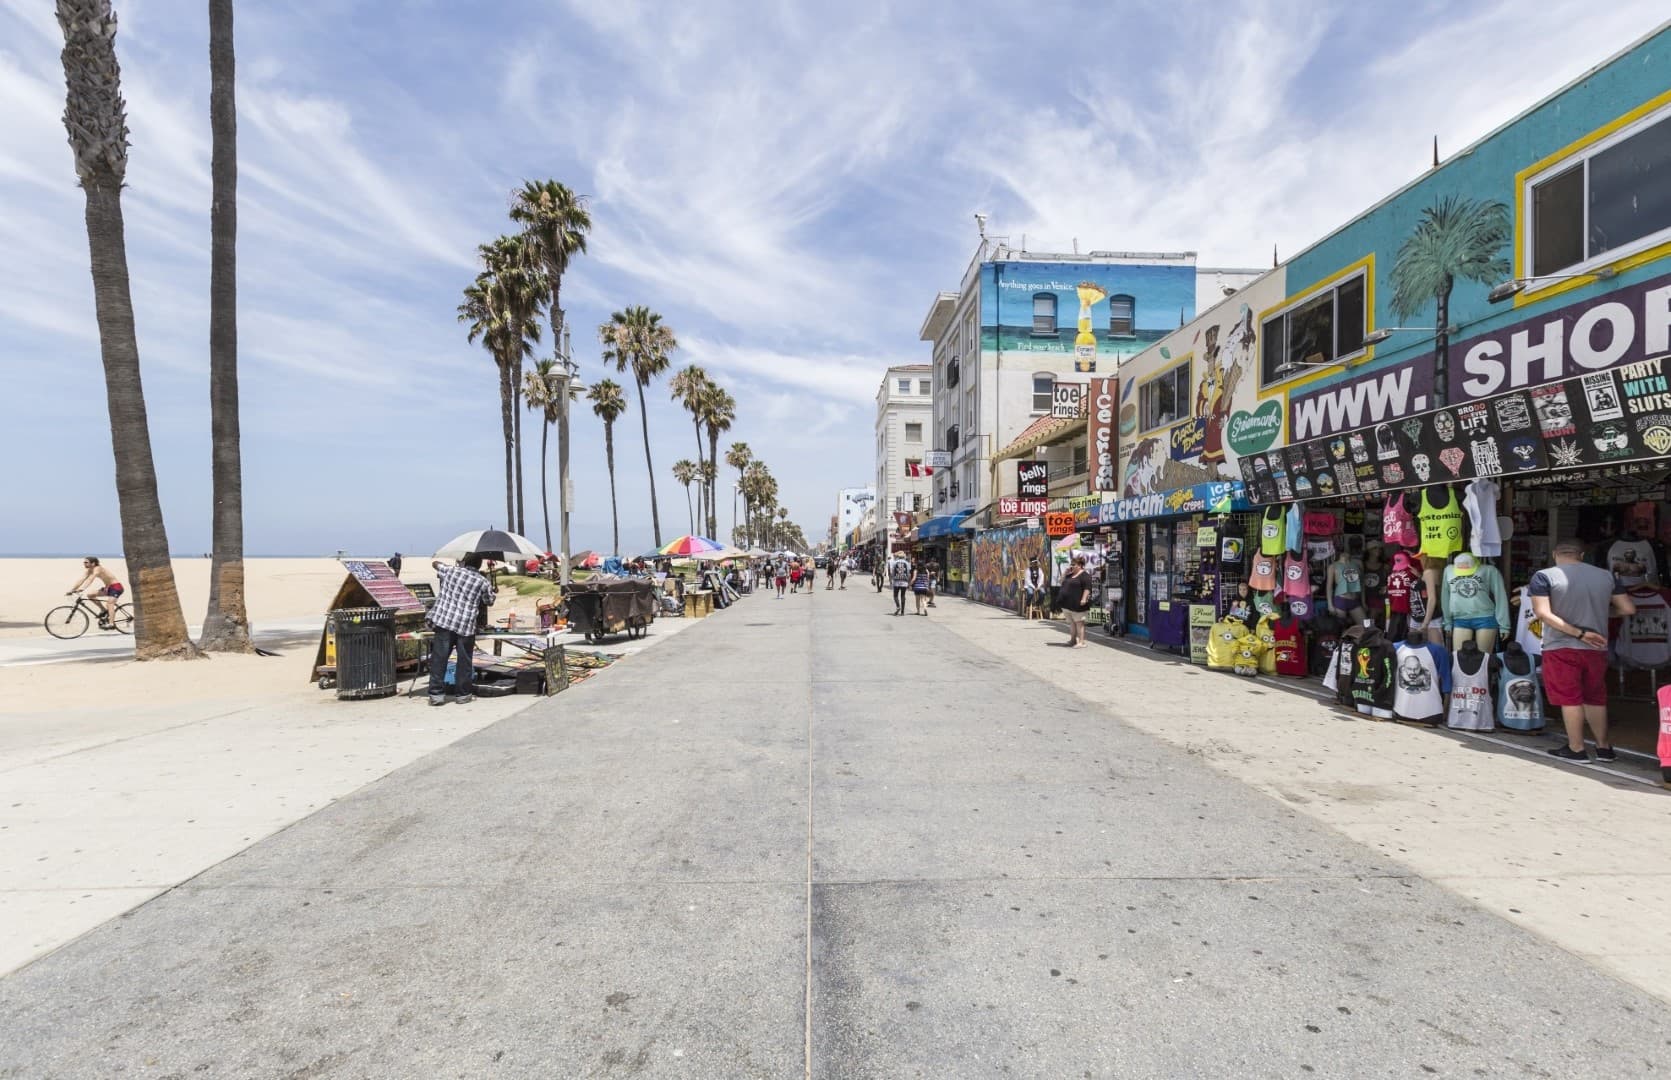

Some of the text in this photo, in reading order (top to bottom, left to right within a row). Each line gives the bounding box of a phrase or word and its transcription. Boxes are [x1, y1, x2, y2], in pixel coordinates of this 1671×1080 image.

[999, 279, 1027, 291] Anything
[1028, 283, 1043, 291] goes
[1051, 281, 1074, 291] Venice.
[1620, 359, 1662, 381] PARTY
[1583, 371, 1612, 386] MISSING
[1623, 375, 1668, 397] WITH
[1053, 386, 1079, 403] toe
[1053, 404, 1079, 416] rings
[1295, 366, 1427, 440] WWW.
[1458, 403, 1486, 415] BRO DO
[1628, 392, 1671, 414] SLUTS
[1460, 414, 1488, 430] LIFT
[1473, 451, 1500, 465] BEFORE
[1019, 464, 1046, 482] belly
[1475, 462, 1503, 477] DATES
[1022, 483, 1046, 496] rings
[1000, 498, 1047, 515] toe rings
[1069, 501, 1081, 510] toe
[1117, 493, 1165, 520] cream
[1048, 515, 1073, 526] toe
[1049, 525, 1073, 534] rings
[1472, 686, 1487, 695] DO
